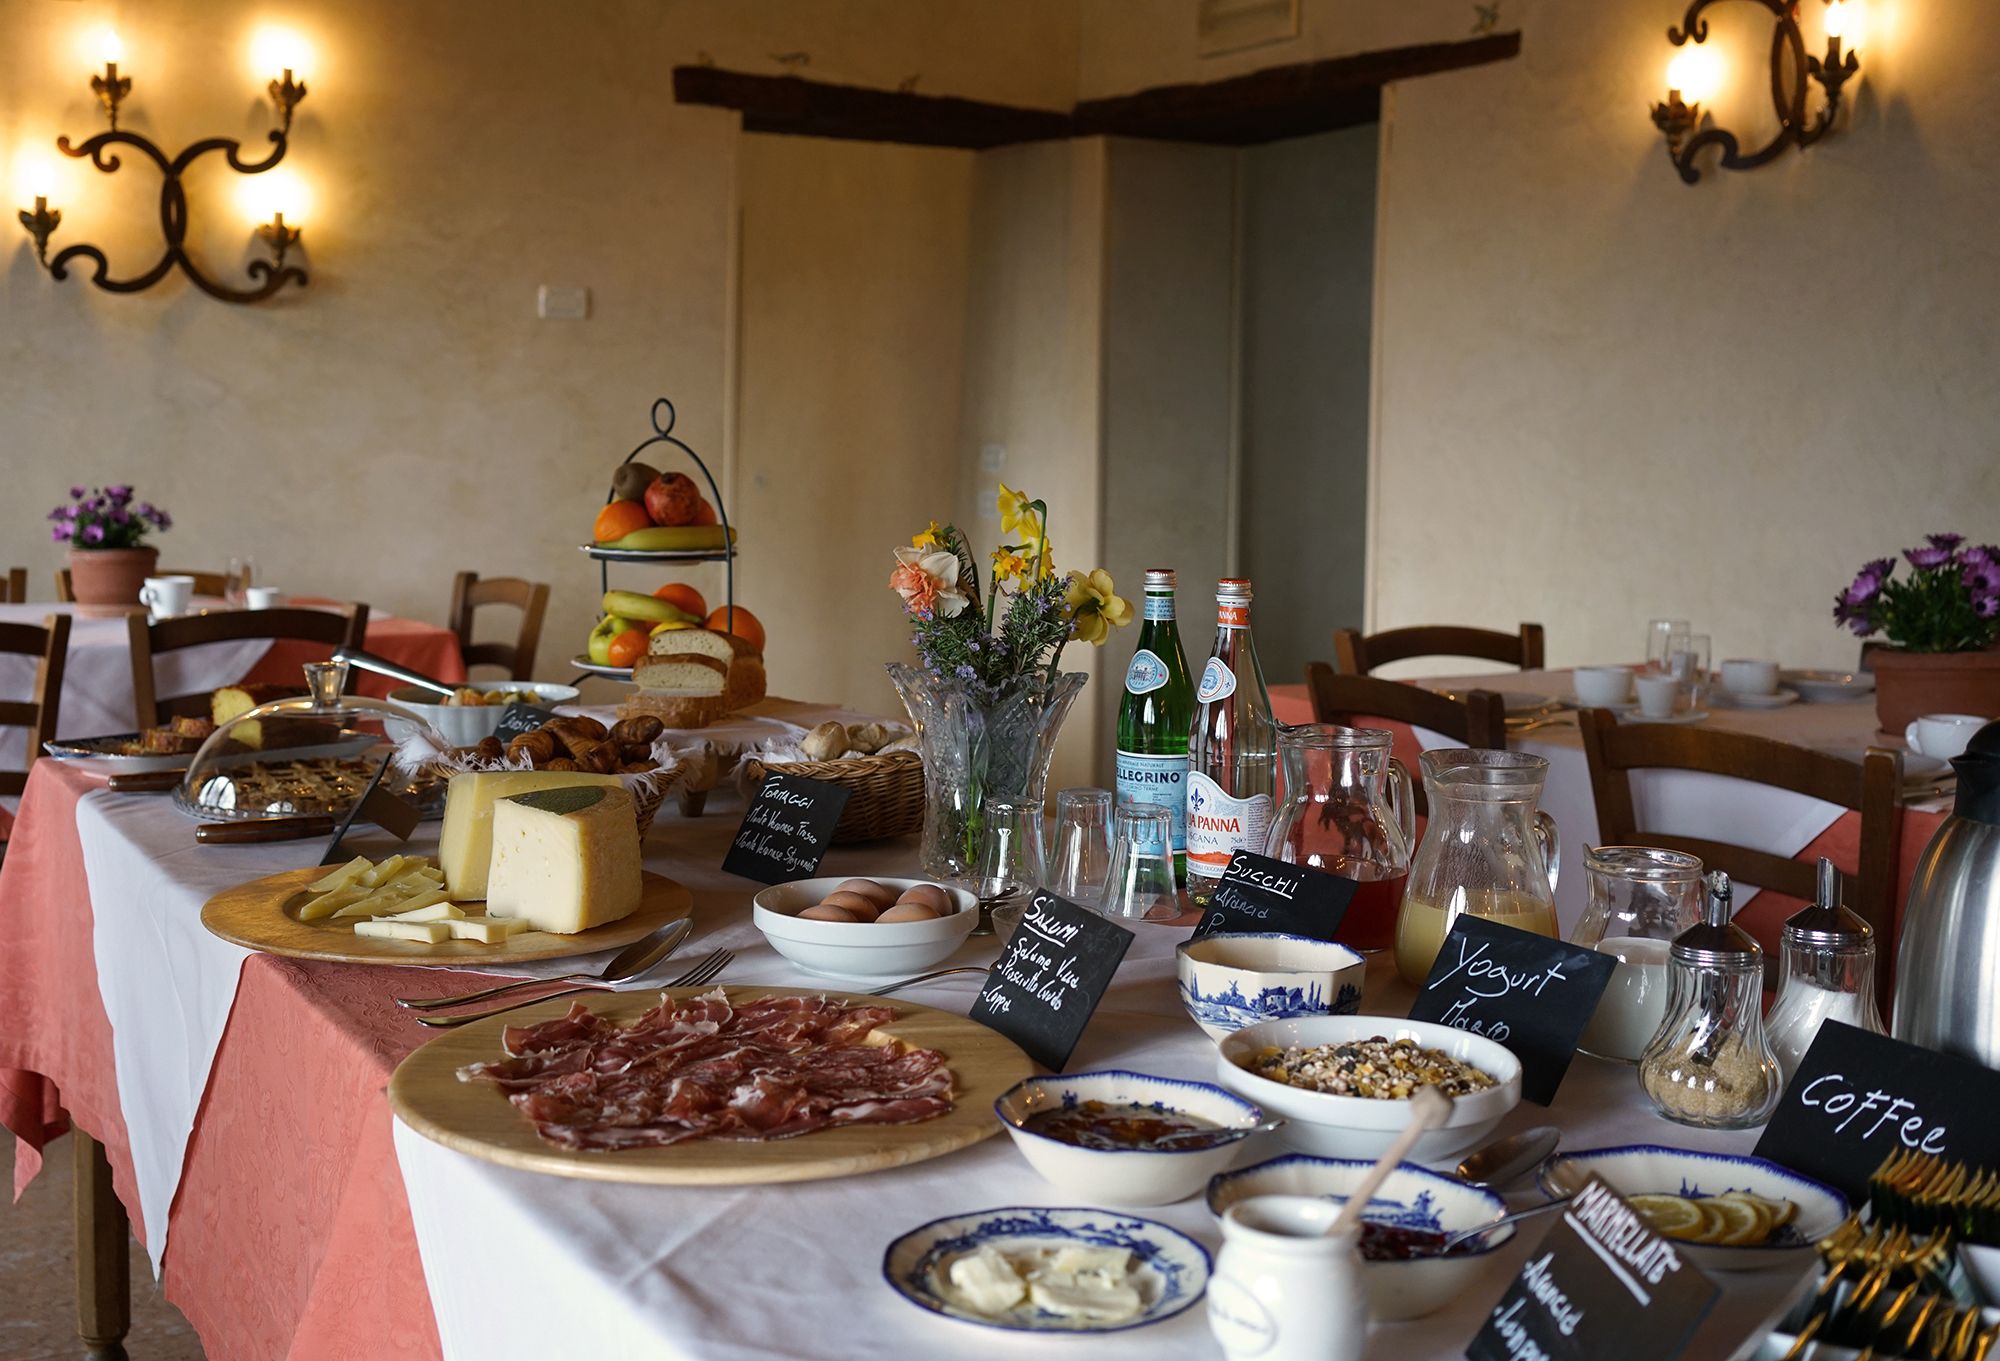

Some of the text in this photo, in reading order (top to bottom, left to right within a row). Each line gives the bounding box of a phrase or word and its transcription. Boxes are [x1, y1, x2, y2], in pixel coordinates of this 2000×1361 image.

[1117, 767, 1180, 783] ELLEGRINO
[1198, 815, 1241, 833] PANNA
[1428, 937, 1567, 998] Yogurt
